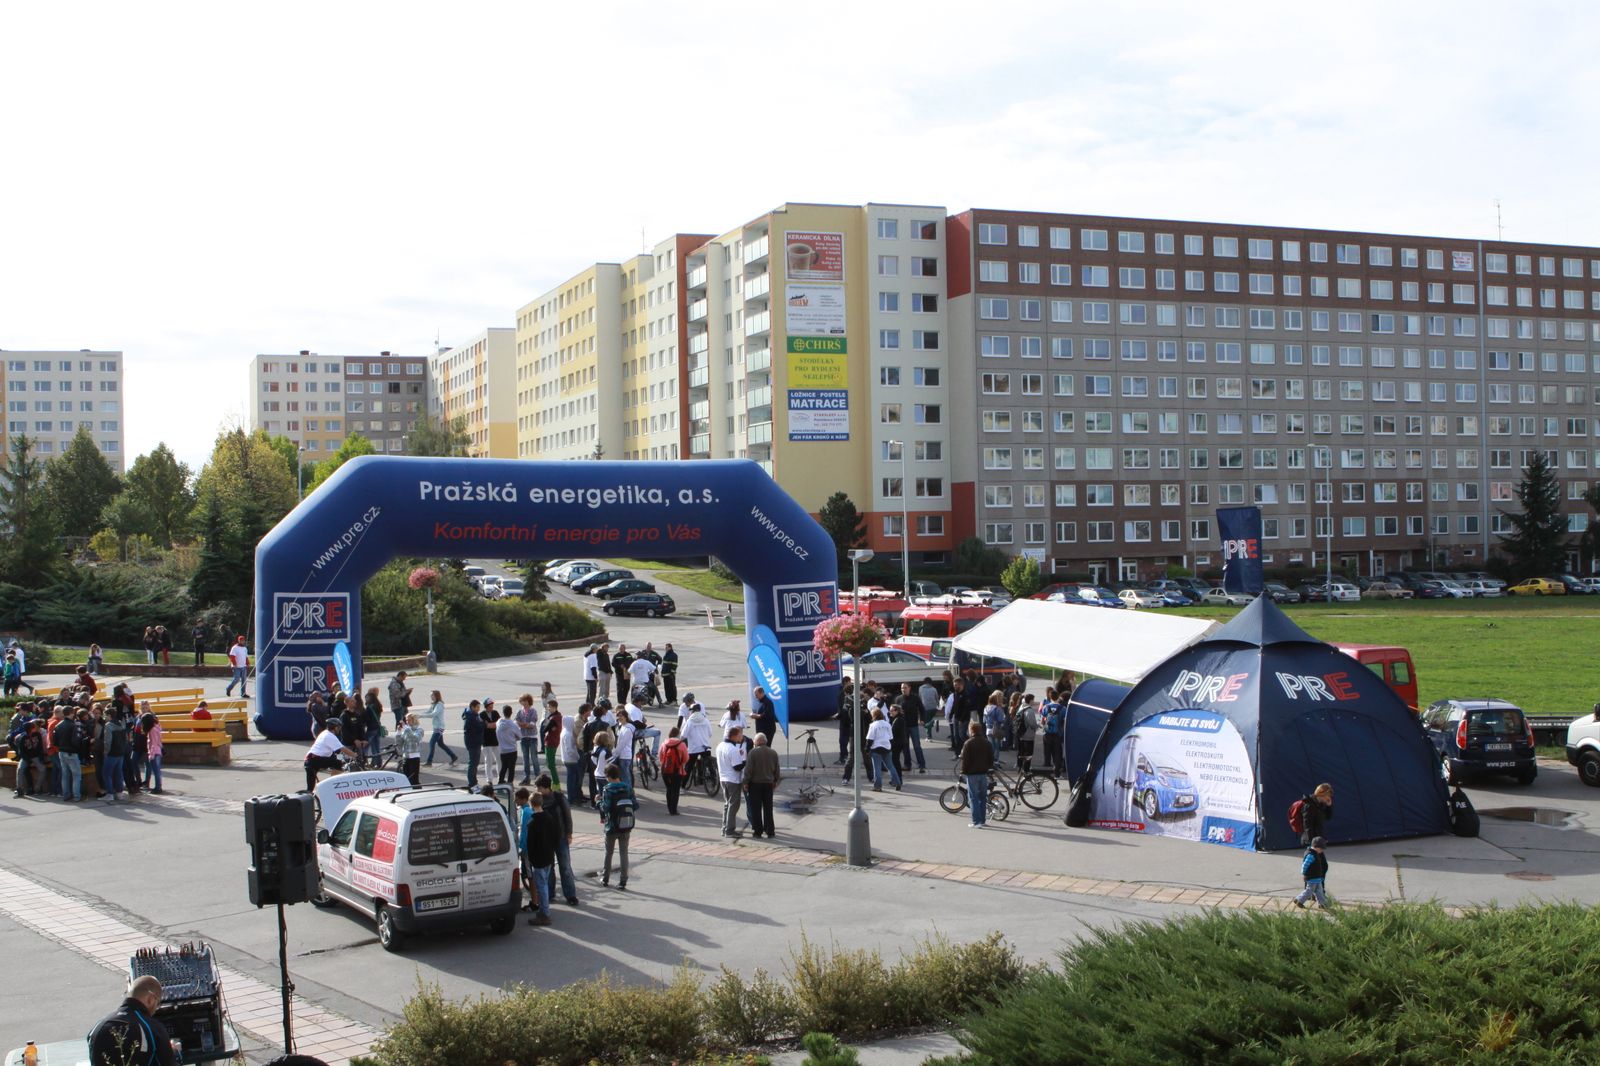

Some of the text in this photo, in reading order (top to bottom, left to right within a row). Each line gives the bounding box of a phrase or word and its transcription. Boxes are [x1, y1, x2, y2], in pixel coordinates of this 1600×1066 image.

[790, 399, 847, 408] MATRACE
[420, 480, 720, 508] Pražská energetika, a.s.
[312, 506, 380, 569] www.pre.cz
[434, 522, 701, 544] Komfortní energie pro Vás
[751, 506, 809, 560] www.pre.cz
[1224, 538, 1258, 560] PRE
[283, 602, 344, 628] PRE
[783, 590, 833, 616] PRE
[1168, 669, 1248, 703] PRE
[1274, 671, 1361, 700] PRE
[1158, 716, 1190, 727] NABIJTE
[1190, 718, 1199, 728] SI
[1208, 826, 1235, 843] PRE
[422, 898, 456, 909] 9S1 1525
